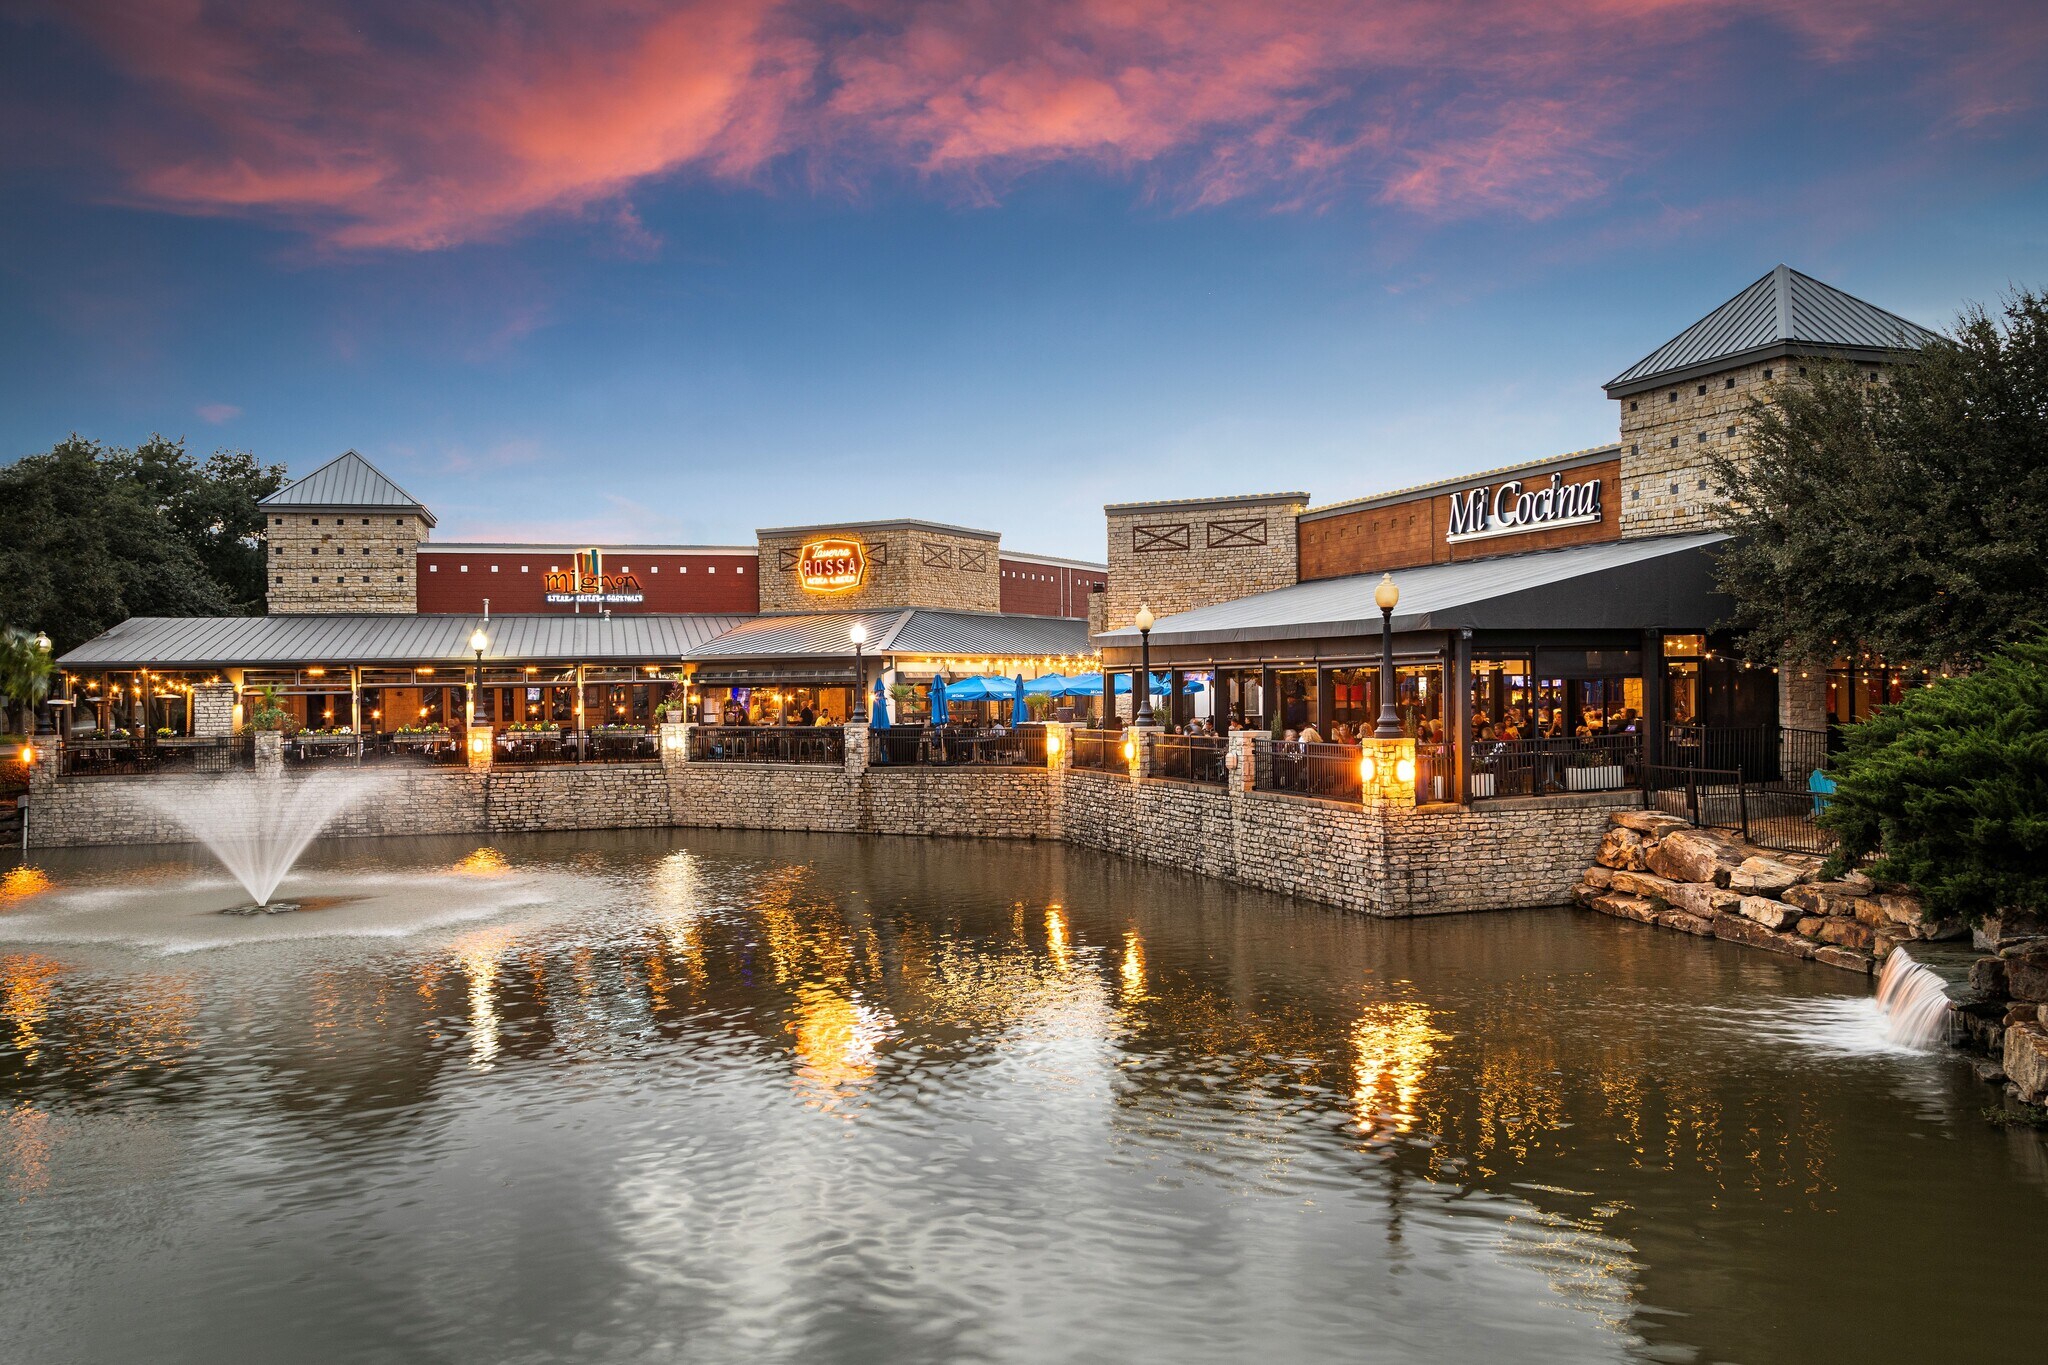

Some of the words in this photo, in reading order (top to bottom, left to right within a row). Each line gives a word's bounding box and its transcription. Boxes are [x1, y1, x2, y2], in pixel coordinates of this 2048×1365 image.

[1446, 487, 1490, 534] Mi
[1494, 472, 1600, 527] Cocina
[812, 545, 850, 558] Taverna
[804, 558, 856, 576] ROSSA
[545, 570, 643, 593] mignon
